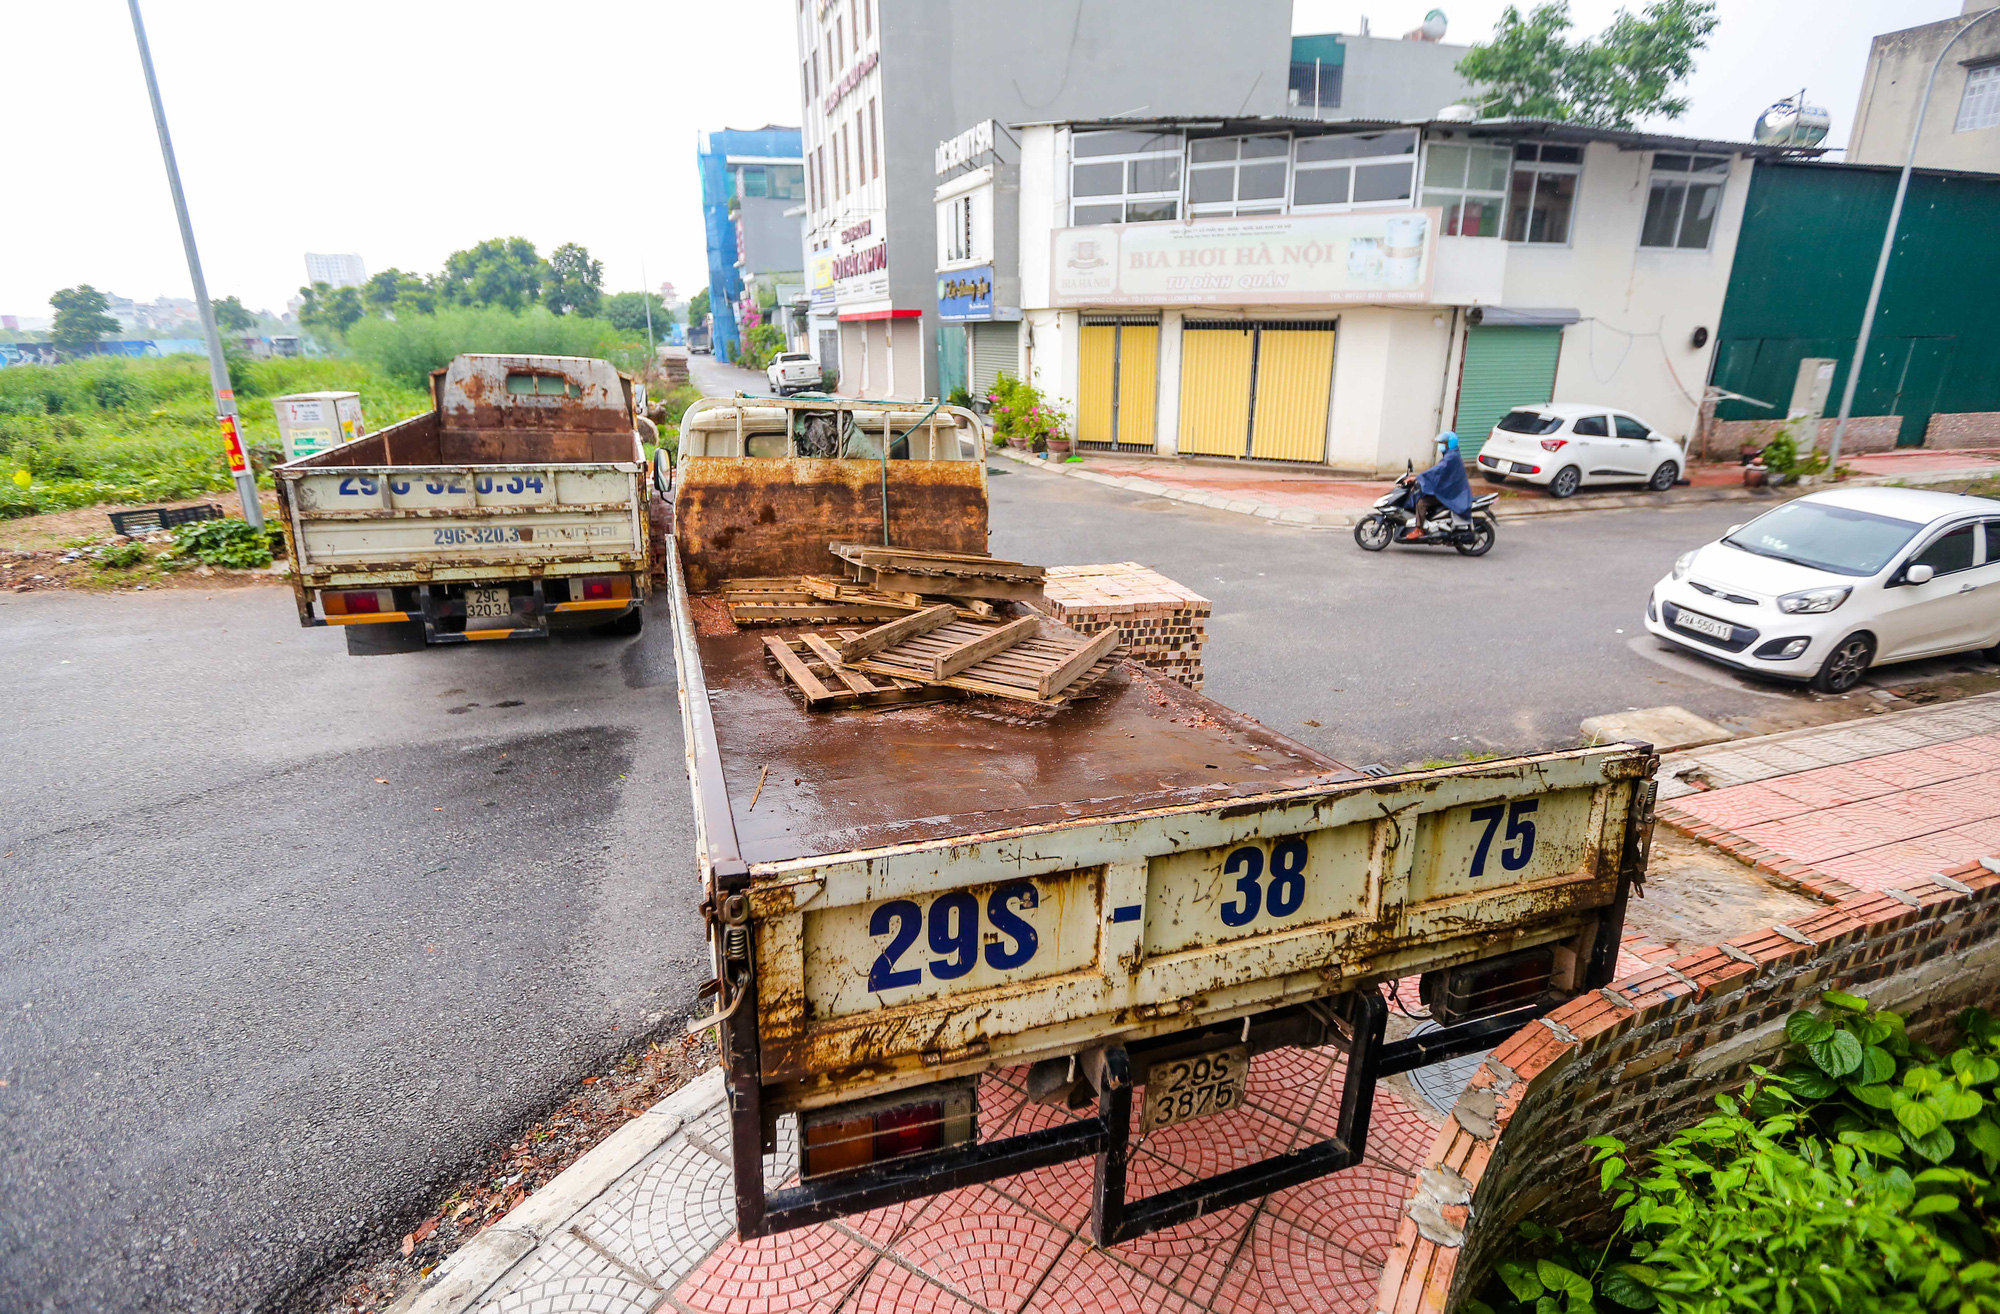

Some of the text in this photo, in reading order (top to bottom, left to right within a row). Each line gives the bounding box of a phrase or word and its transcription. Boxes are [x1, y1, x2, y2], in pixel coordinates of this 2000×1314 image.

[1129, 240, 1336, 270] BIA HƠI HÀ NỘI
[1190, 272, 1233, 290] ĐÌNH
[1239, 271, 1290, 289] QUÁN
[433, 526, 534, 545] 29C-320.3
[536, 525, 617, 539] HYUNDAI
[475, 588, 499, 602] 29C
[467, 602, 510, 617] 320.34
[868, 881, 1039, 993] 29S
[1219, 839, 1309, 928] 38
[1468, 800, 1540, 878] 75
[1169, 1052, 1231, 1092] 29S
[1154, 1080, 1236, 1125] 3875
